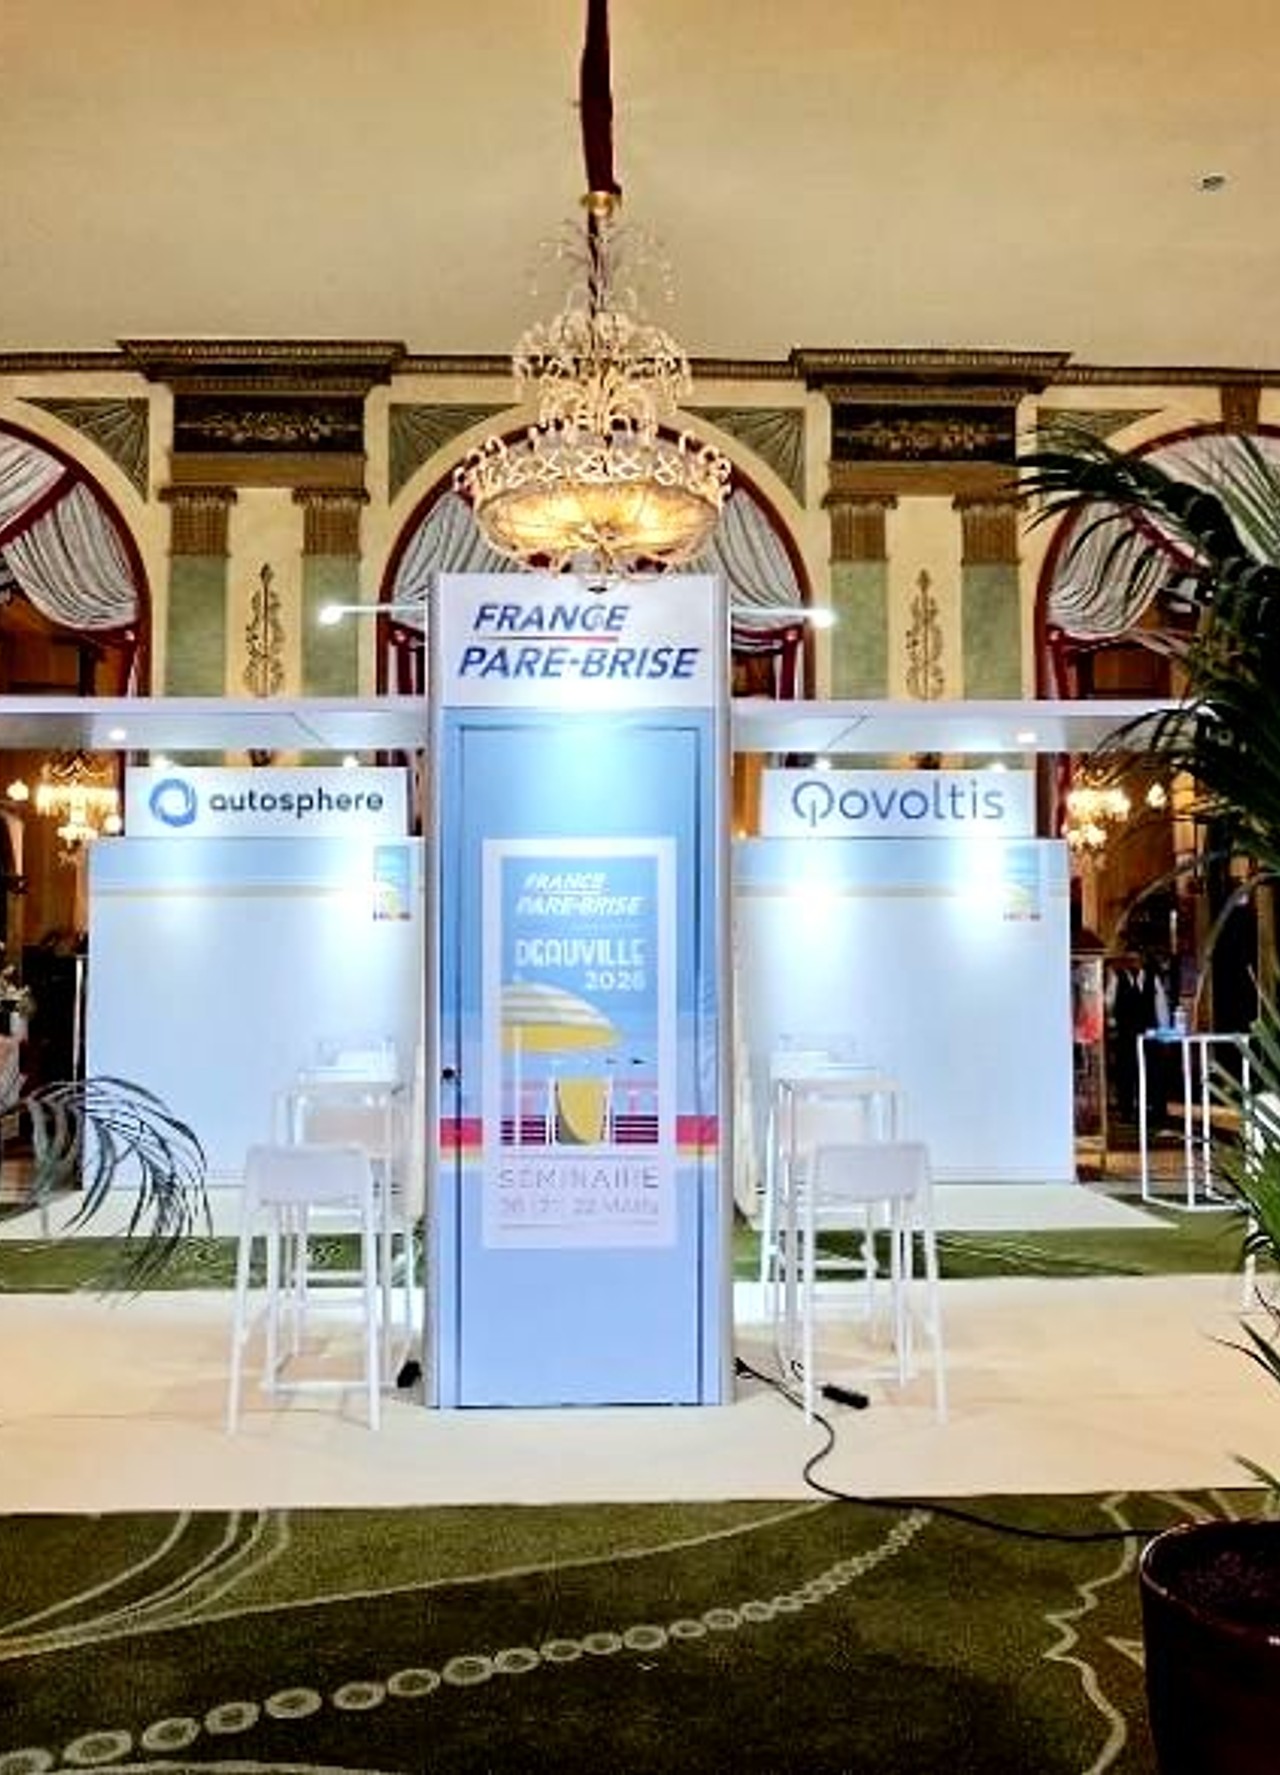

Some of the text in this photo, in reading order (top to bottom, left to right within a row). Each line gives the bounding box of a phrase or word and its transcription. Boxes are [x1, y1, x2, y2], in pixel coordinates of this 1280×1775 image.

[472, 603, 630, 632] FRANCE
[458, 646, 701, 679] PARE-BRISE
[208, 786, 385, 819] autosphere
[791, 778, 1005, 828] Qovoltis
[516, 896, 644, 916] PARE-BRISE
